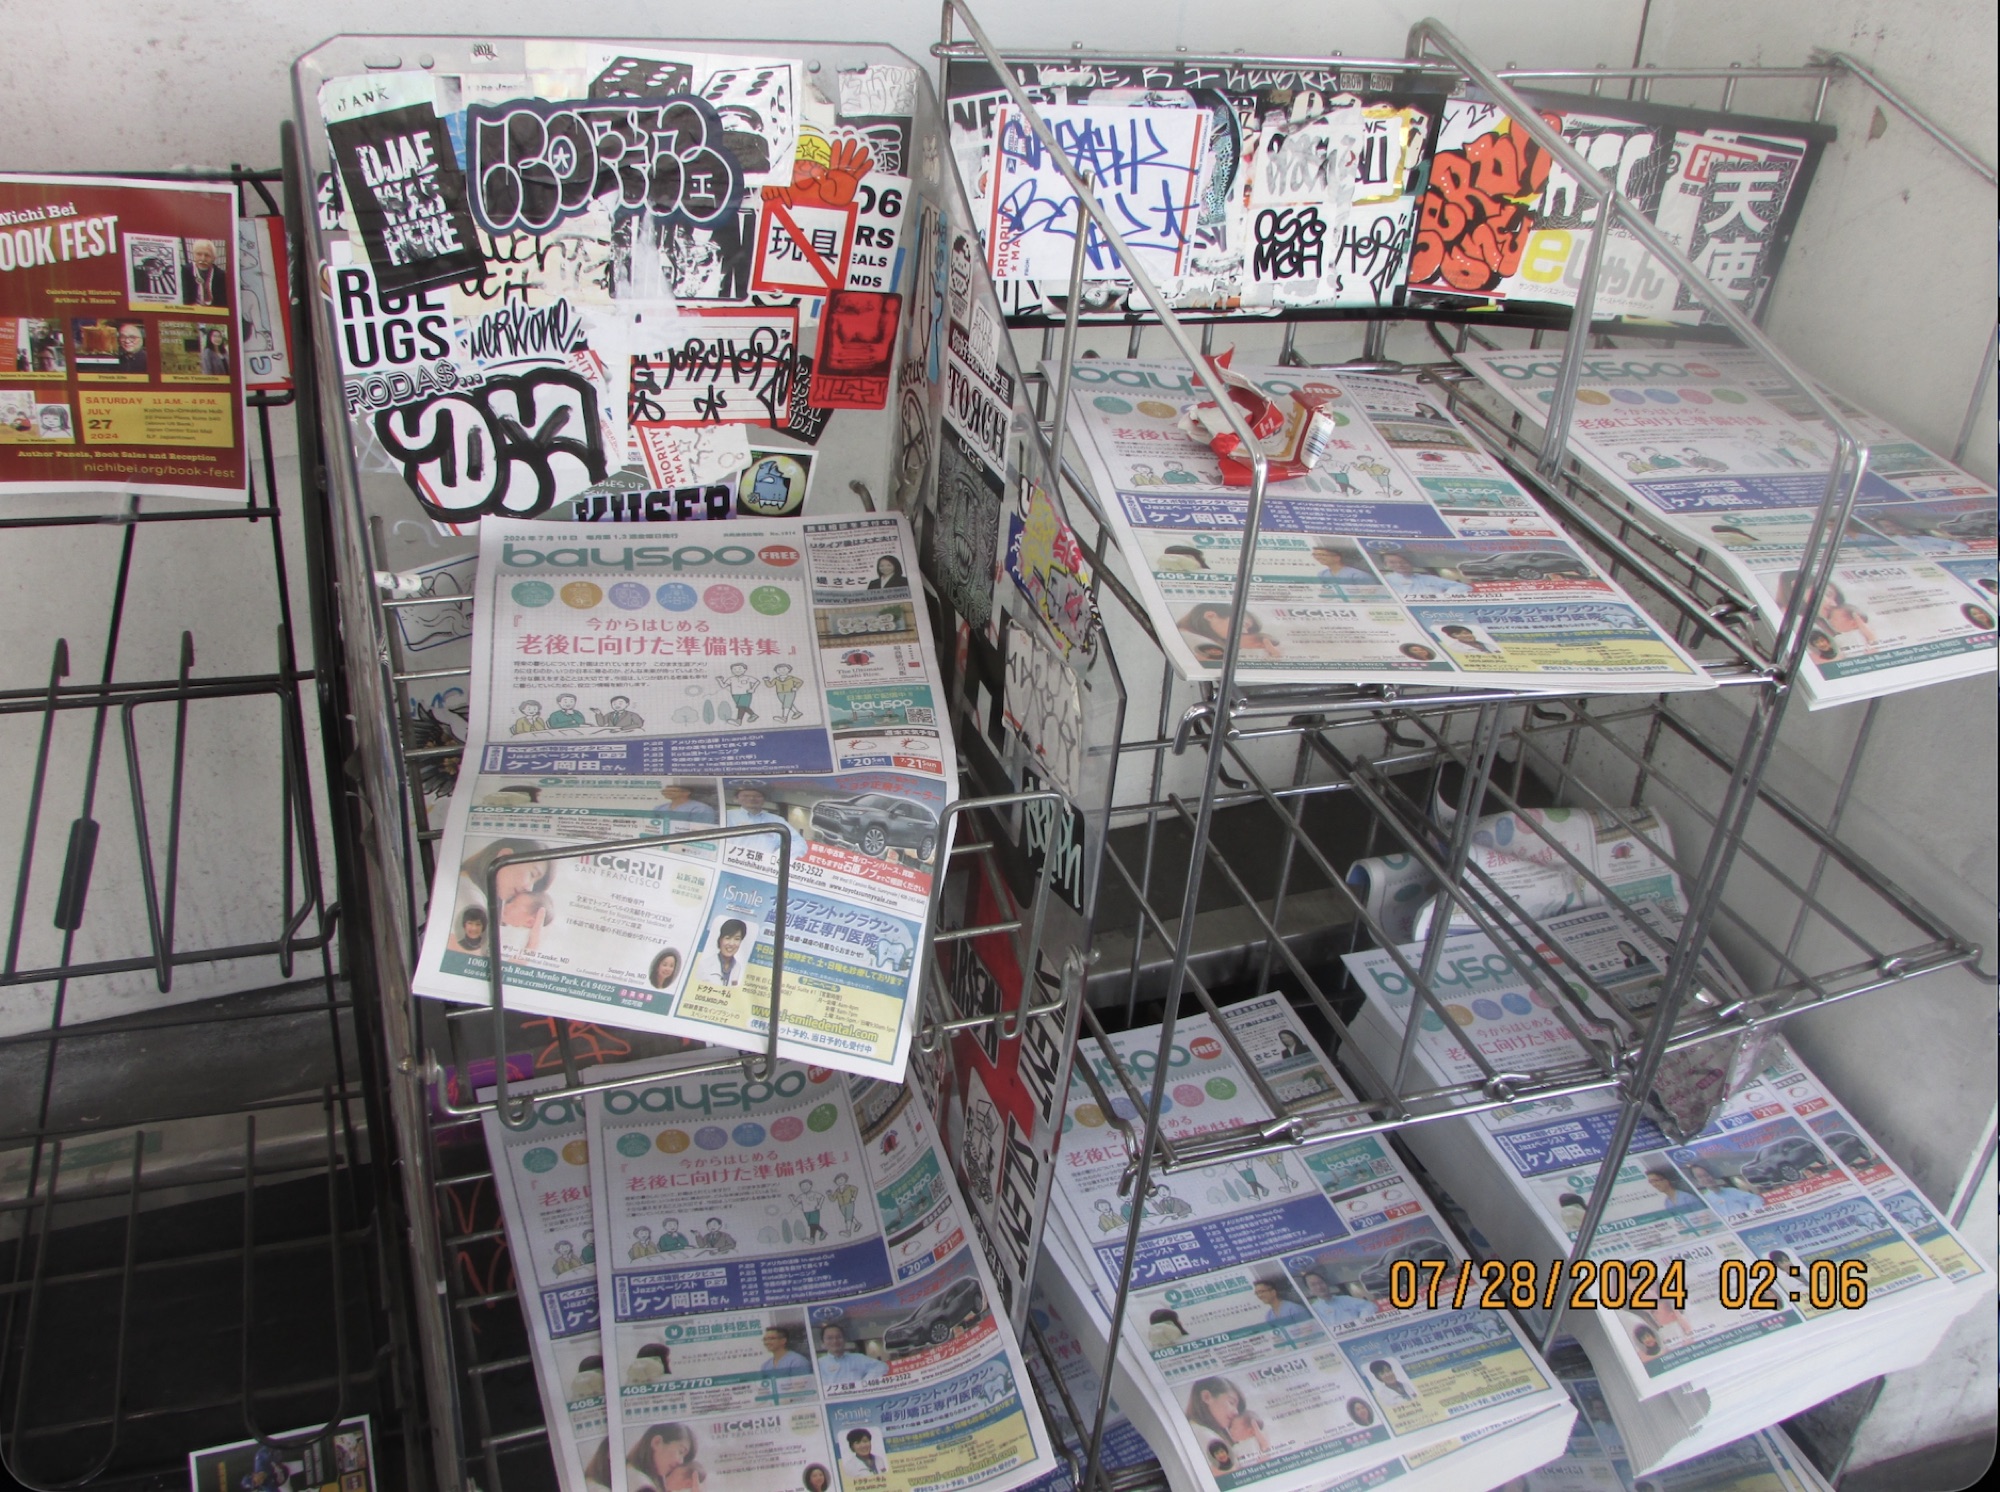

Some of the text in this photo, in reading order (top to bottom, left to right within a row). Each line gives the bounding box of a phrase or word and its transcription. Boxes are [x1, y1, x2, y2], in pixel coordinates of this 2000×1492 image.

[47, 202, 78, 221] Bei
[58, 215, 119, 262] FEST
[770, 227, 839, 266] 玩具
[46, 288, 121, 297] Celebrating Historian
[54, 297, 79, 305] Arthur
[344, 314, 451, 368] UGS
[85, 397, 143, 405] SATURDAY
[88, 419, 113, 430] 27
[18, 450, 54, 459] Author
[56, 451, 93, 461] Panels,
[169, 453, 217, 462] Reception
[958, 437, 985, 473] UGS
[84, 463, 236, 478] nichibei.org/book-fest
[502, 542, 755, 571] bayspo
[761, 551, 799, 561] FREE
[833, 576, 868, 586] さとこ
[851, 699, 913, 710] bayspo
[473, 806, 590, 815] 408-775-7770
[729, 846, 745, 857] ノブ
[594, 854, 664, 881] CCRM
[574, 864, 661, 890] SAN FRANCISCO
[722, 883, 764, 908] iSmile
[466, 957, 616, 994] 1060 Road, Menlo Park, CA 94025
[1192, 1041, 1221, 1056] FREE
[633, 1281, 698, 1295] Jazzベーシスト
[634, 1291, 730, 1311] ケン岡田さん
[623, 1377, 713, 1395] 408-775-7770
[834, 1406, 872, 1423] iSmile
[722, 1415, 781, 1434] CCRM
